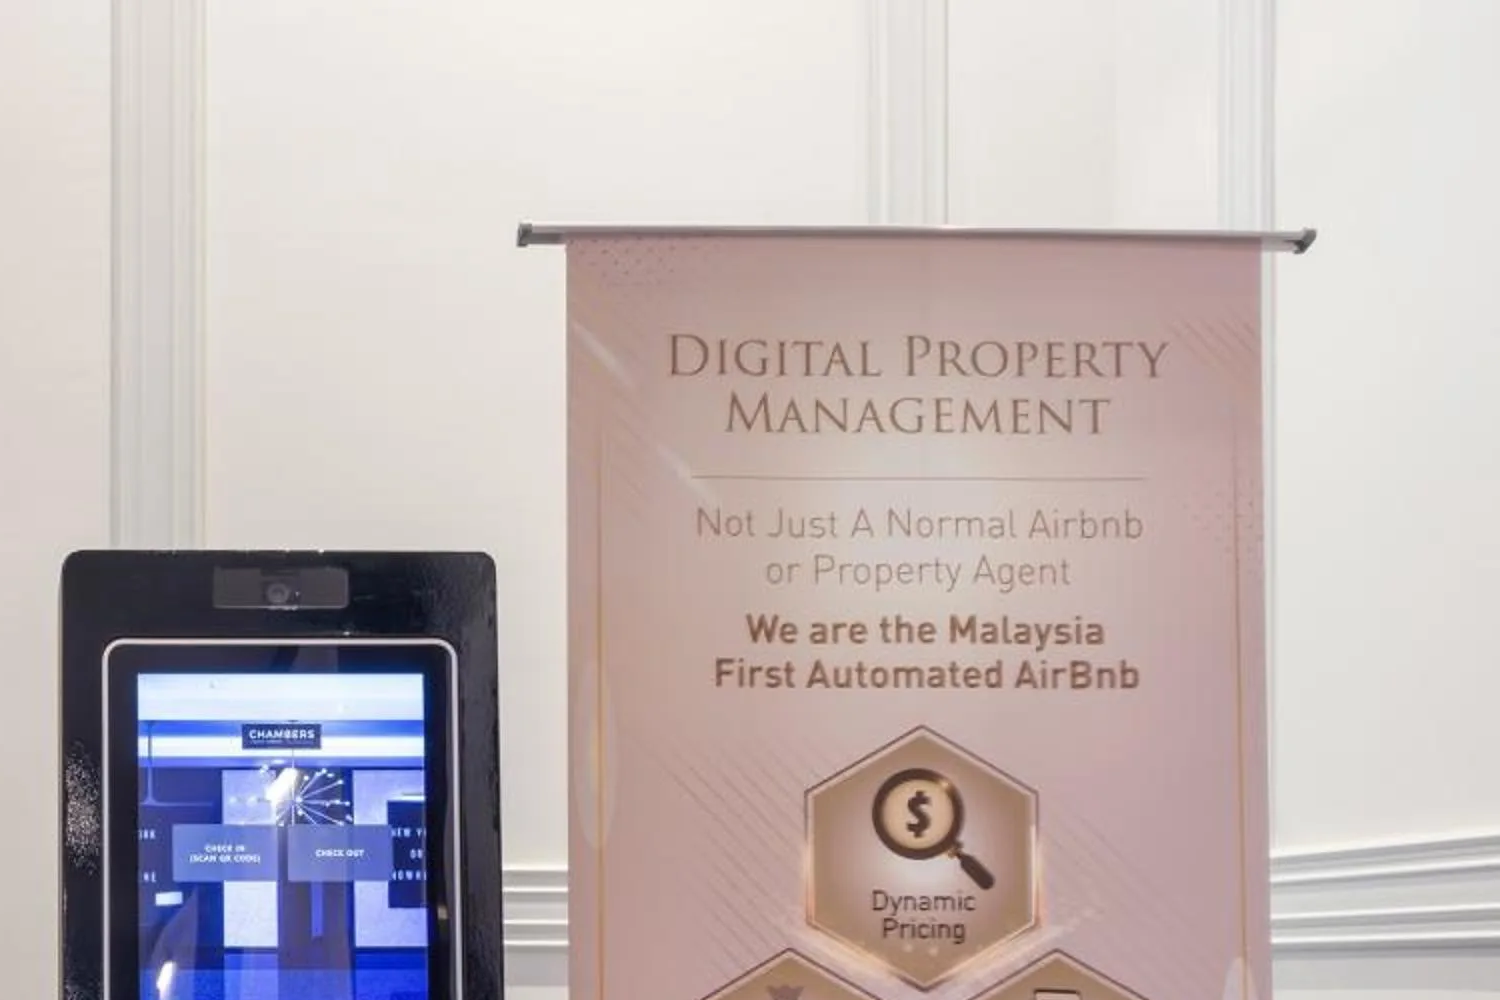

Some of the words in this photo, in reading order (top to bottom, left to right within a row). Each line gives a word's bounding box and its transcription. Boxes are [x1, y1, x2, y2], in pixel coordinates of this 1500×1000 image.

[694, 506, 757, 540] Not
[767, 506, 839, 540] Just
[850, 506, 875, 540] A
[886, 506, 1017, 541] Normal
[1027, 506, 1145, 541] Airbnb
[764, 560, 799, 588] or
[813, 554, 963, 593] Property
[973, 554, 1072, 594] Agent
[745, 613, 799, 645] We
[808, 618, 870, 646] are
[879, 613, 937, 646] the
[949, 613, 1106, 652] Malaysia
[714, 659, 797, 690] First
[807, 659, 1004, 690] Automated
[1014, 659, 1141, 691] AirBnb
[249, 729, 315, 740] CHAMBERS
[871, 889, 976, 916] Dynamic
[881, 917, 966, 944] Pricing
